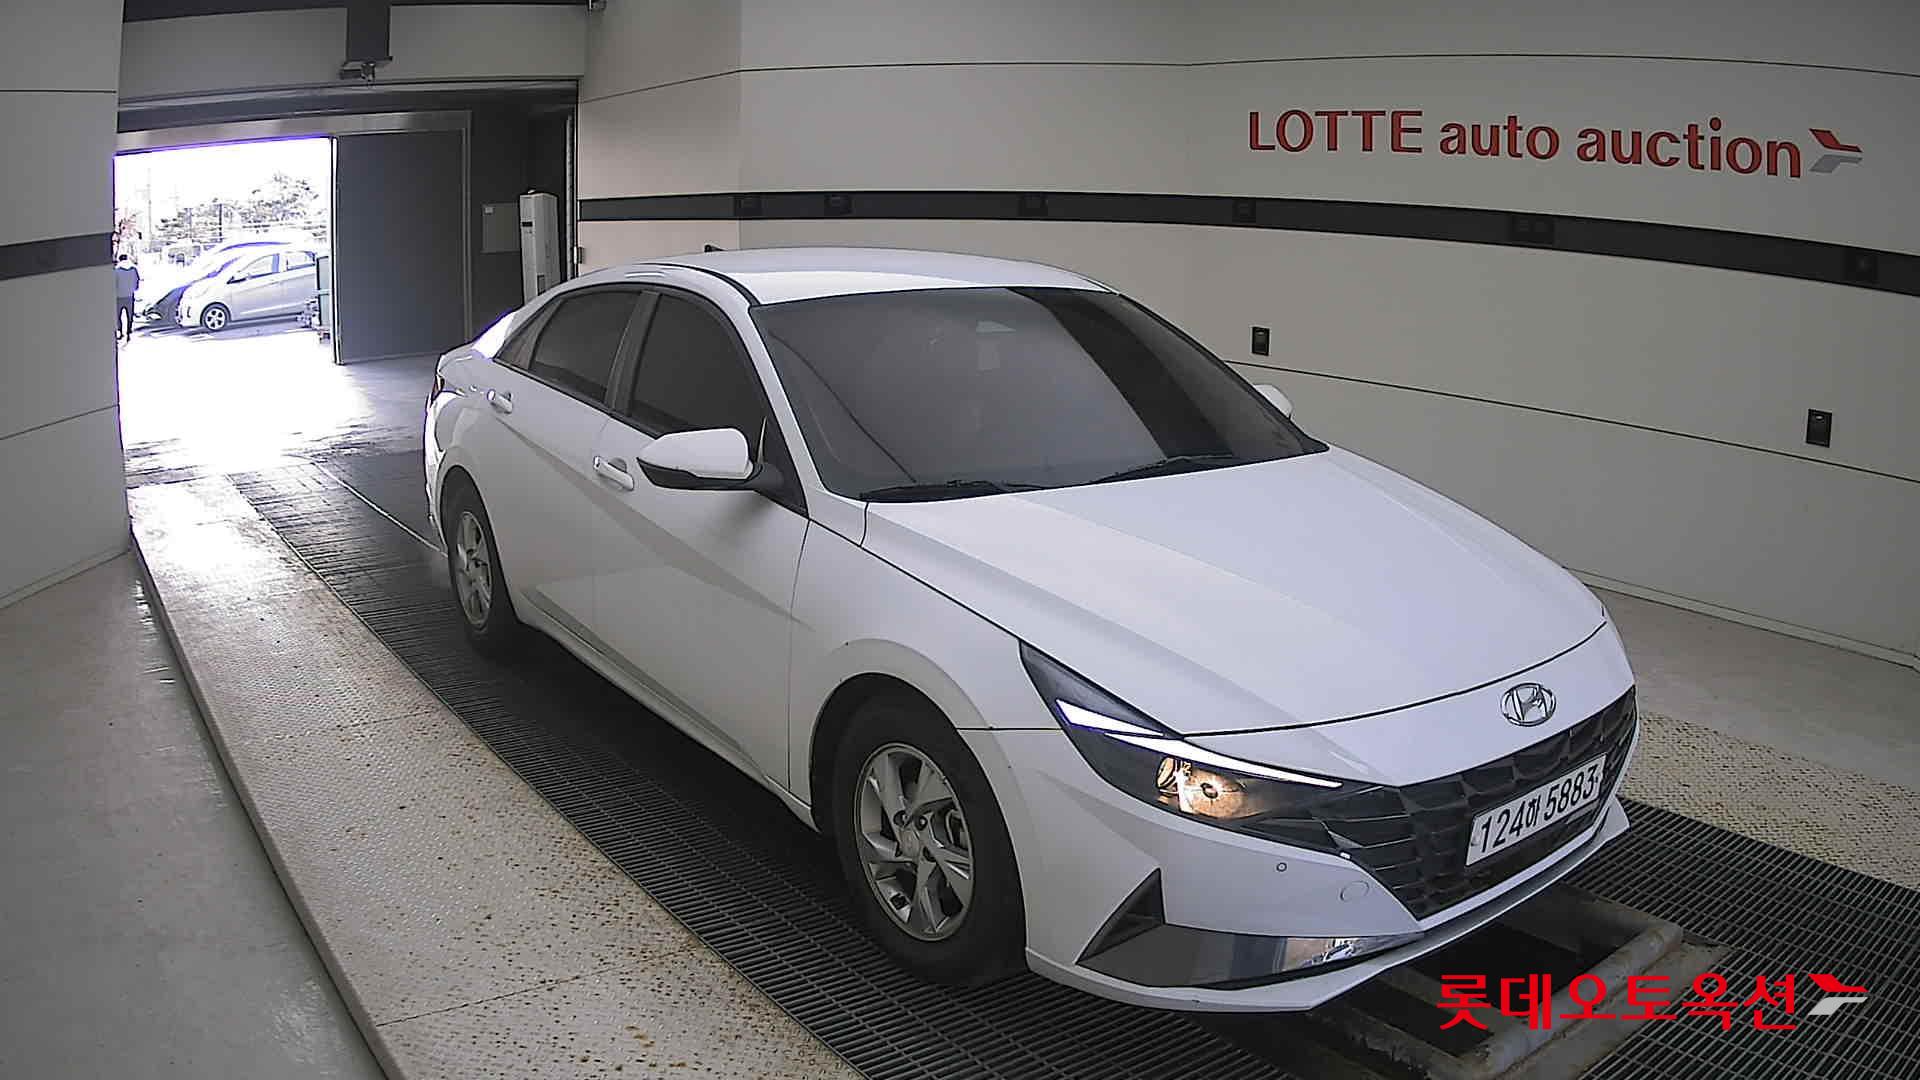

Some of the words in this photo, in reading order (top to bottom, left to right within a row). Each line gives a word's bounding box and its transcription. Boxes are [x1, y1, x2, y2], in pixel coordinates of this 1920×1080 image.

[1249, 111, 1423, 154] LOTTE
[1440, 116, 1560, 160] auto
[1577, 117, 1801, 178] auction
[1544, 763, 1599, 821] 5883
